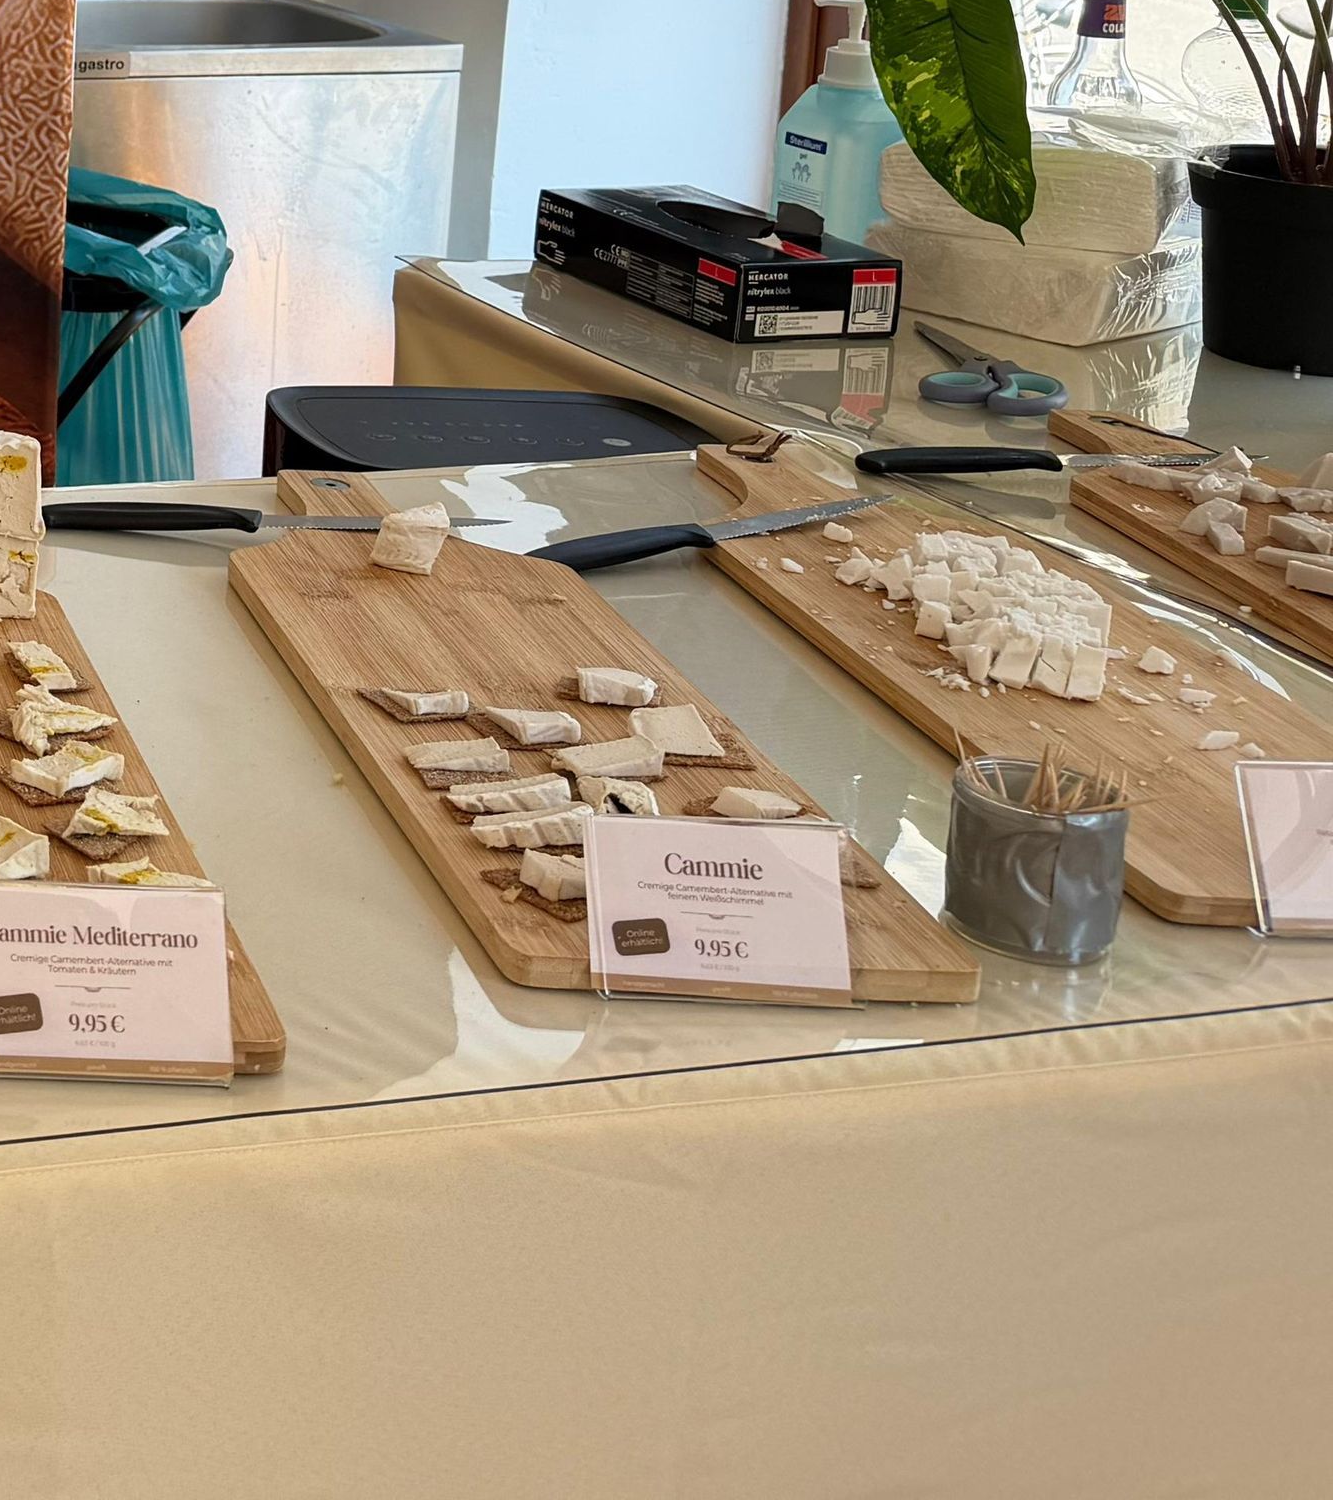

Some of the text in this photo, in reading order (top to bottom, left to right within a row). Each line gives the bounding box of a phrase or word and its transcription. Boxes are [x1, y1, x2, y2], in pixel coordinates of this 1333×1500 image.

[71, 59, 124, 73] gastro
[541, 201, 574, 219] MERCATOR
[748, 273, 788, 281] MERCATOR
[747, 286, 774, 297] nitrylex
[664, 852, 763, 880] Cammie
[637, 881, 674, 892] Cremige
[676, 883, 776, 897] Camembert-Alternative
[72, 925, 198, 948] Mediterrano
[626, 929, 654, 938] Online
[735, 941, 749, 958] €
[10, 953, 173, 966] Cremige Camembert-Alternative mit
[48, 965, 136, 975] Tomaten & Kräutern
[111, 1015, 125, 1033] €
